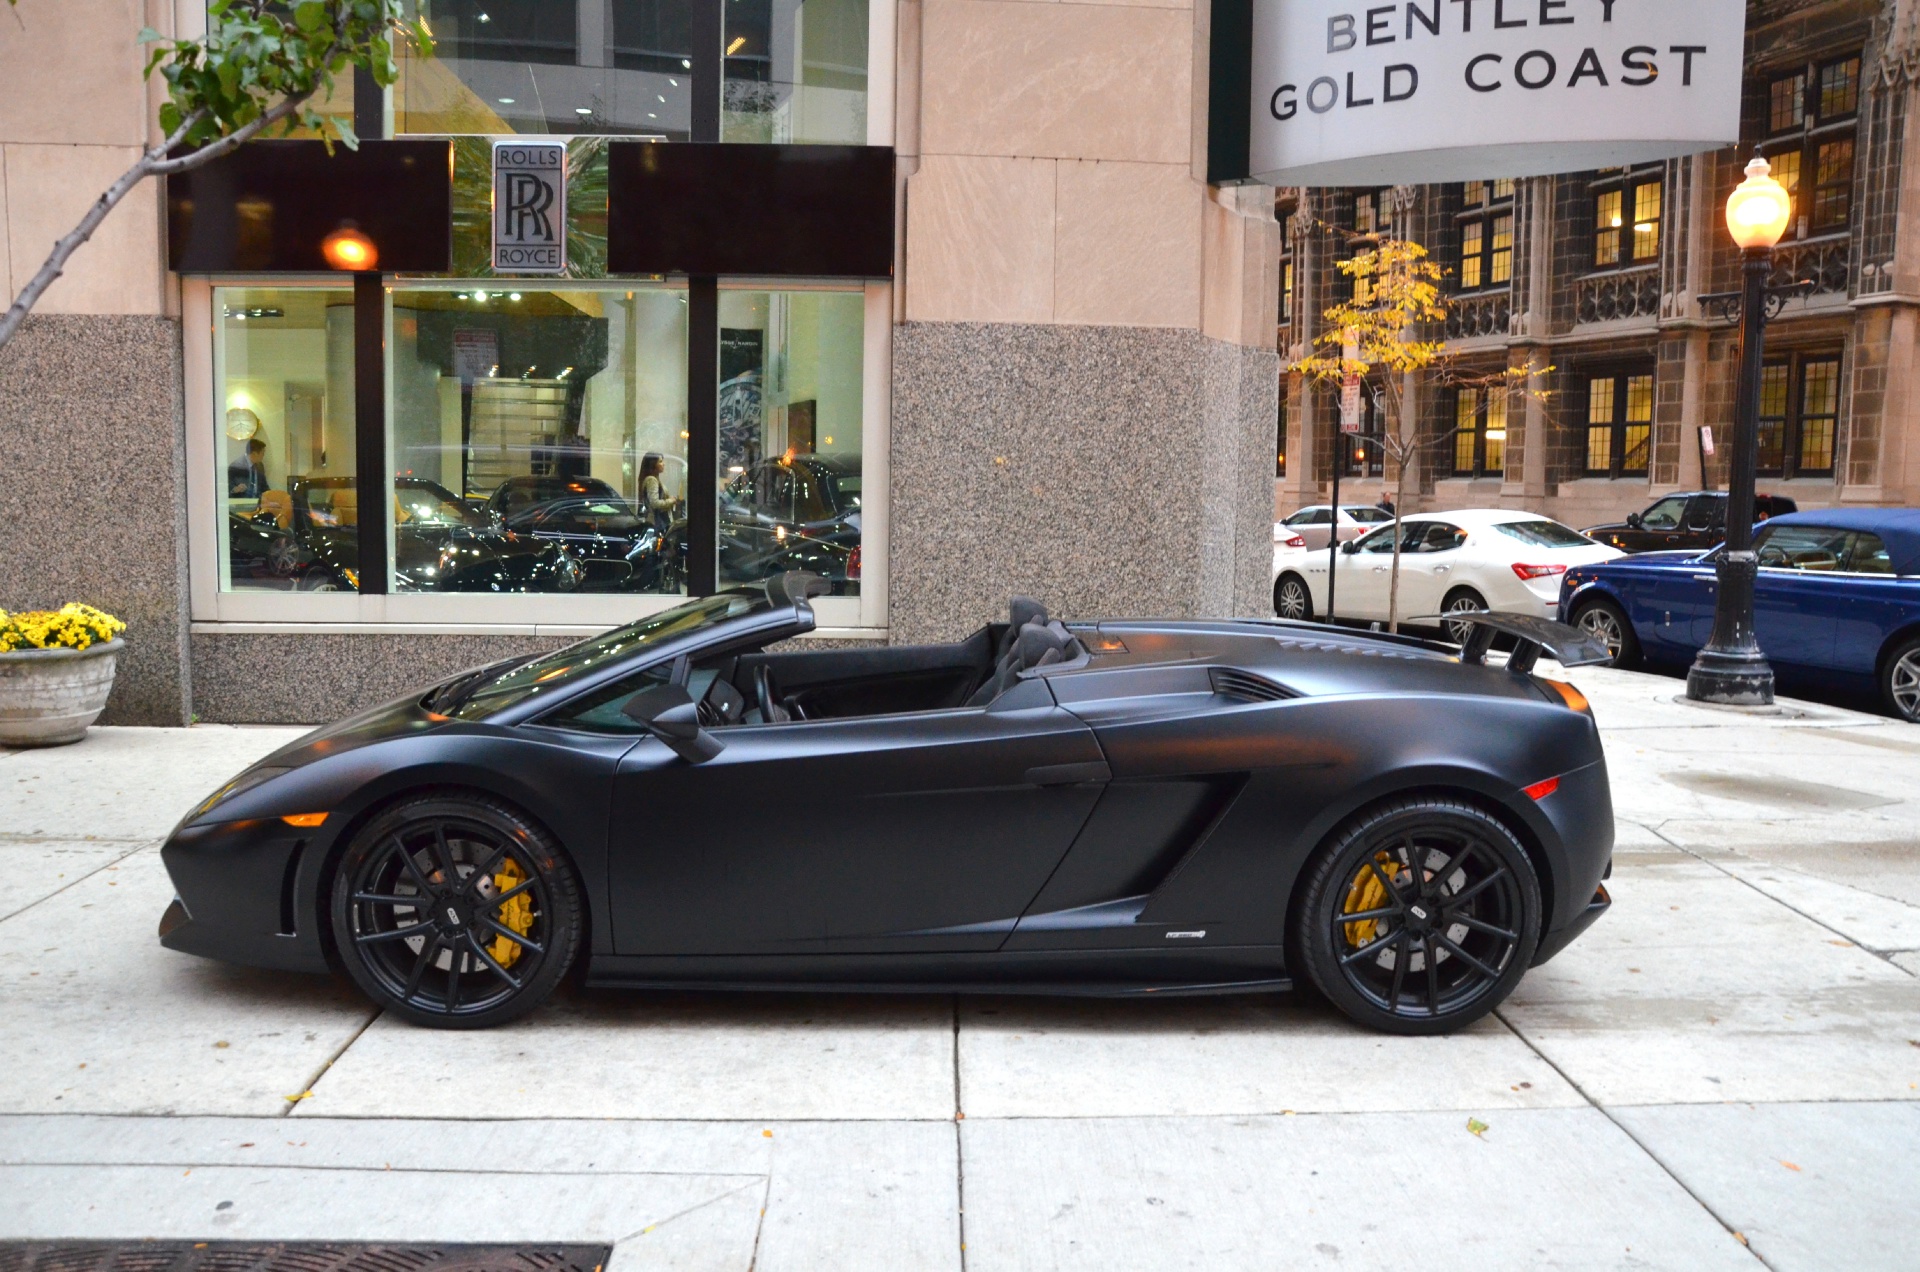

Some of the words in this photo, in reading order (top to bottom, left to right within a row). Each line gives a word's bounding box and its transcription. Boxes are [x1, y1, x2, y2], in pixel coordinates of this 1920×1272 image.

[1270, 63, 1419, 121] GOLD
[1465, 46, 1707, 93] COAST
[500, 150, 557, 165] ROLLS
[500, 249, 556, 264] ROYCE
